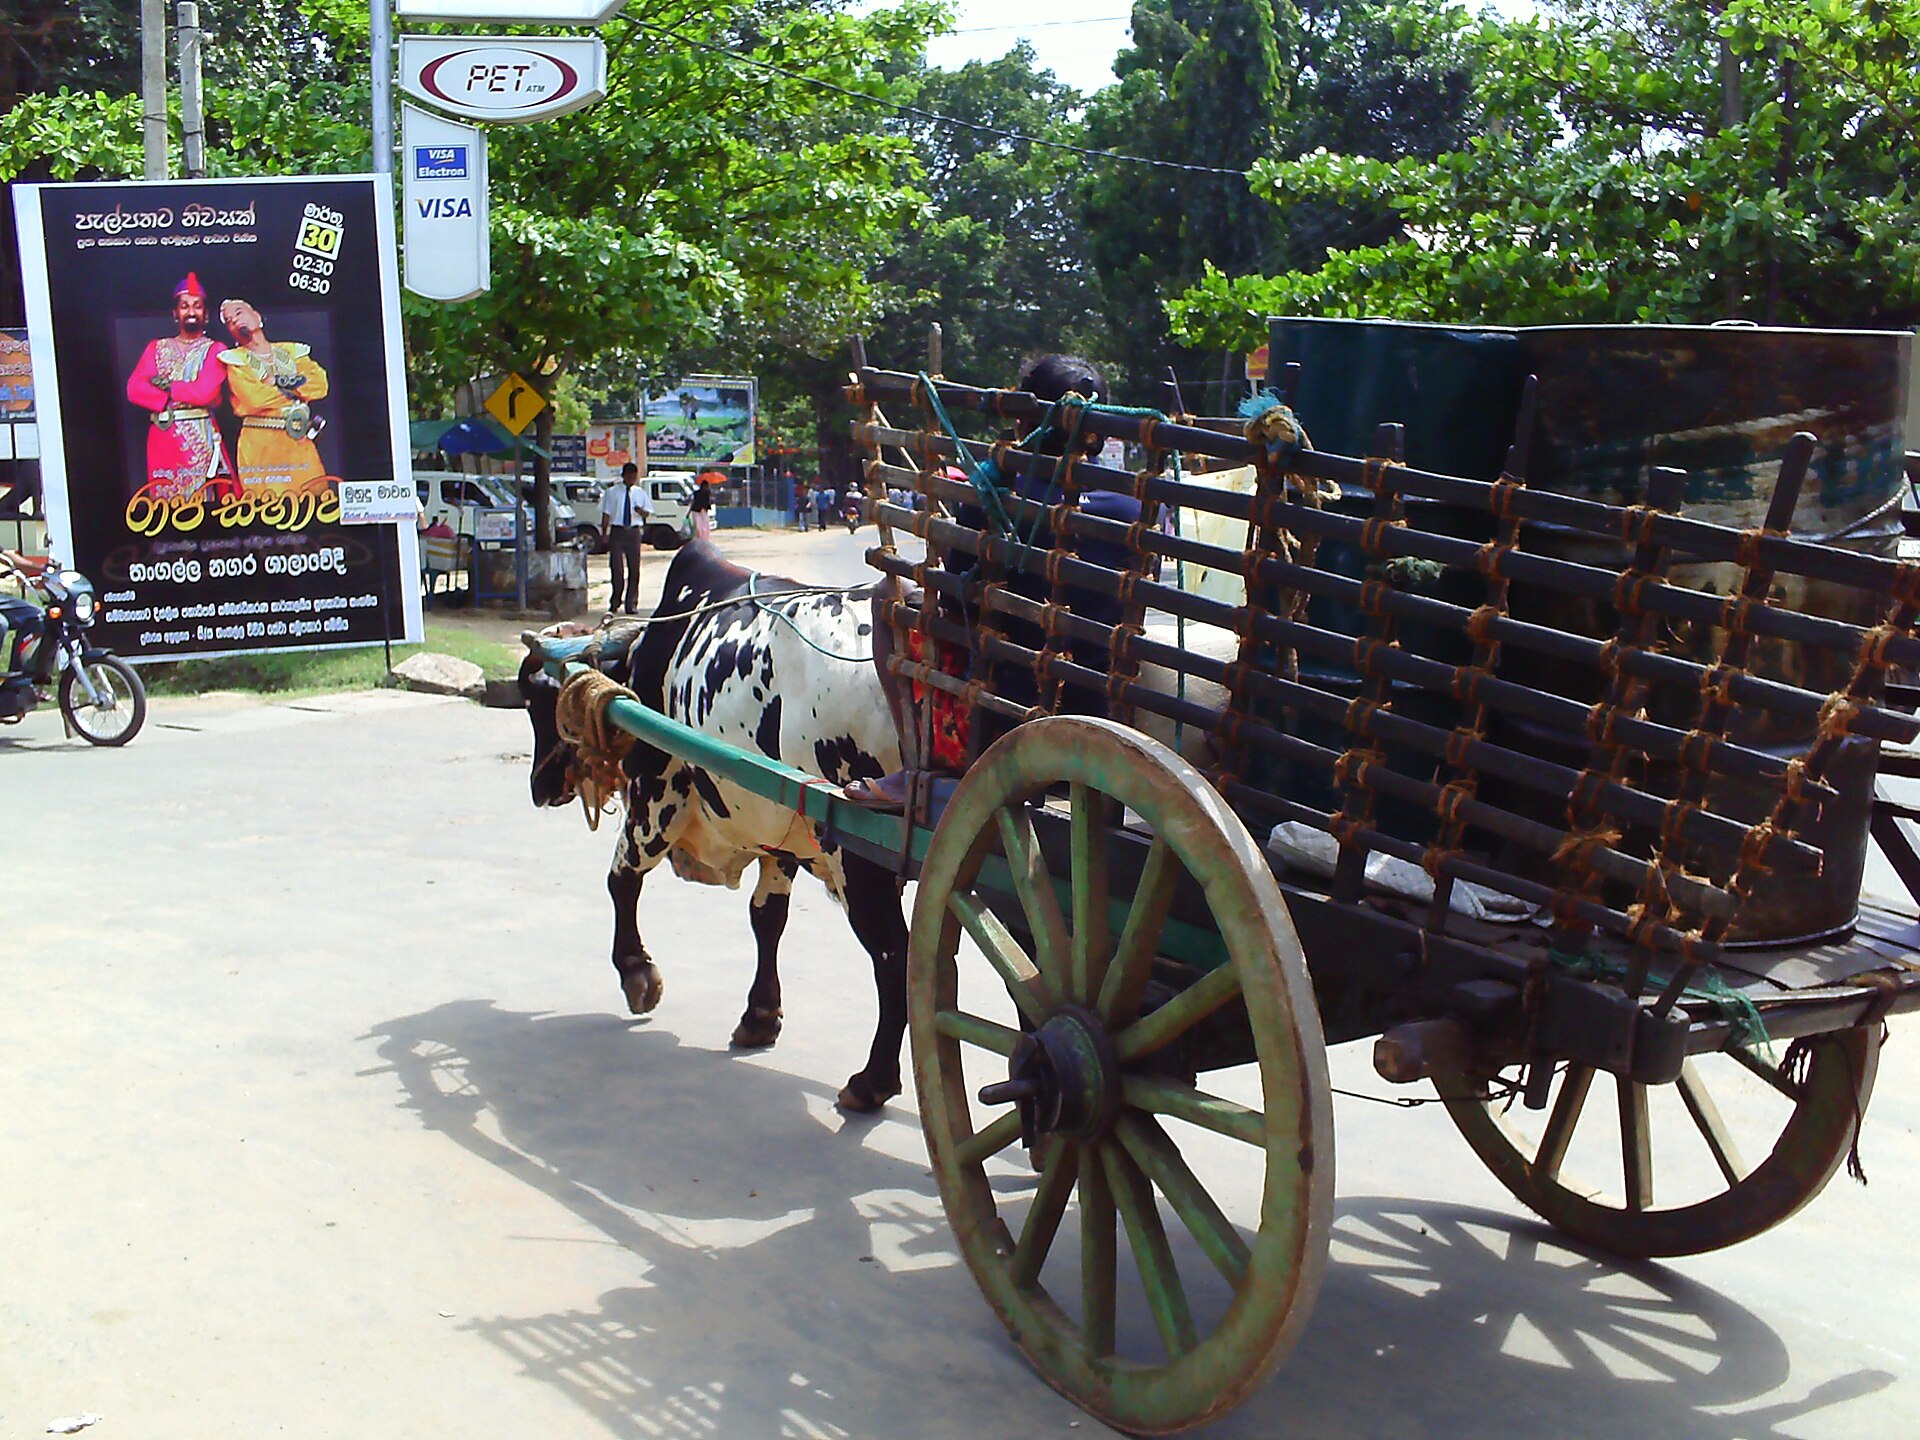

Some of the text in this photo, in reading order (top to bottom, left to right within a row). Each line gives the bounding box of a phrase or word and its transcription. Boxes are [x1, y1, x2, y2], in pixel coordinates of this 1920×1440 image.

[466, 65, 530, 92] PET
[526, 85, 545, 93] ATM
[428, 149, 455, 159] VISA
[418, 167, 465, 177] Electron
[75, 200, 256, 235] පැල්පතට නිවසක්
[415, 198, 472, 218] VISA
[303, 224, 337, 252] 30
[293, 254, 334, 276] 02:30
[289, 272, 330, 295] 06:30
[345, 485, 411, 504] මුහුදු මාවත
[126, 479, 222, 537] රාජ
[129, 558, 202, 583] තංගල්ල
[209, 553, 257, 578] නගර
